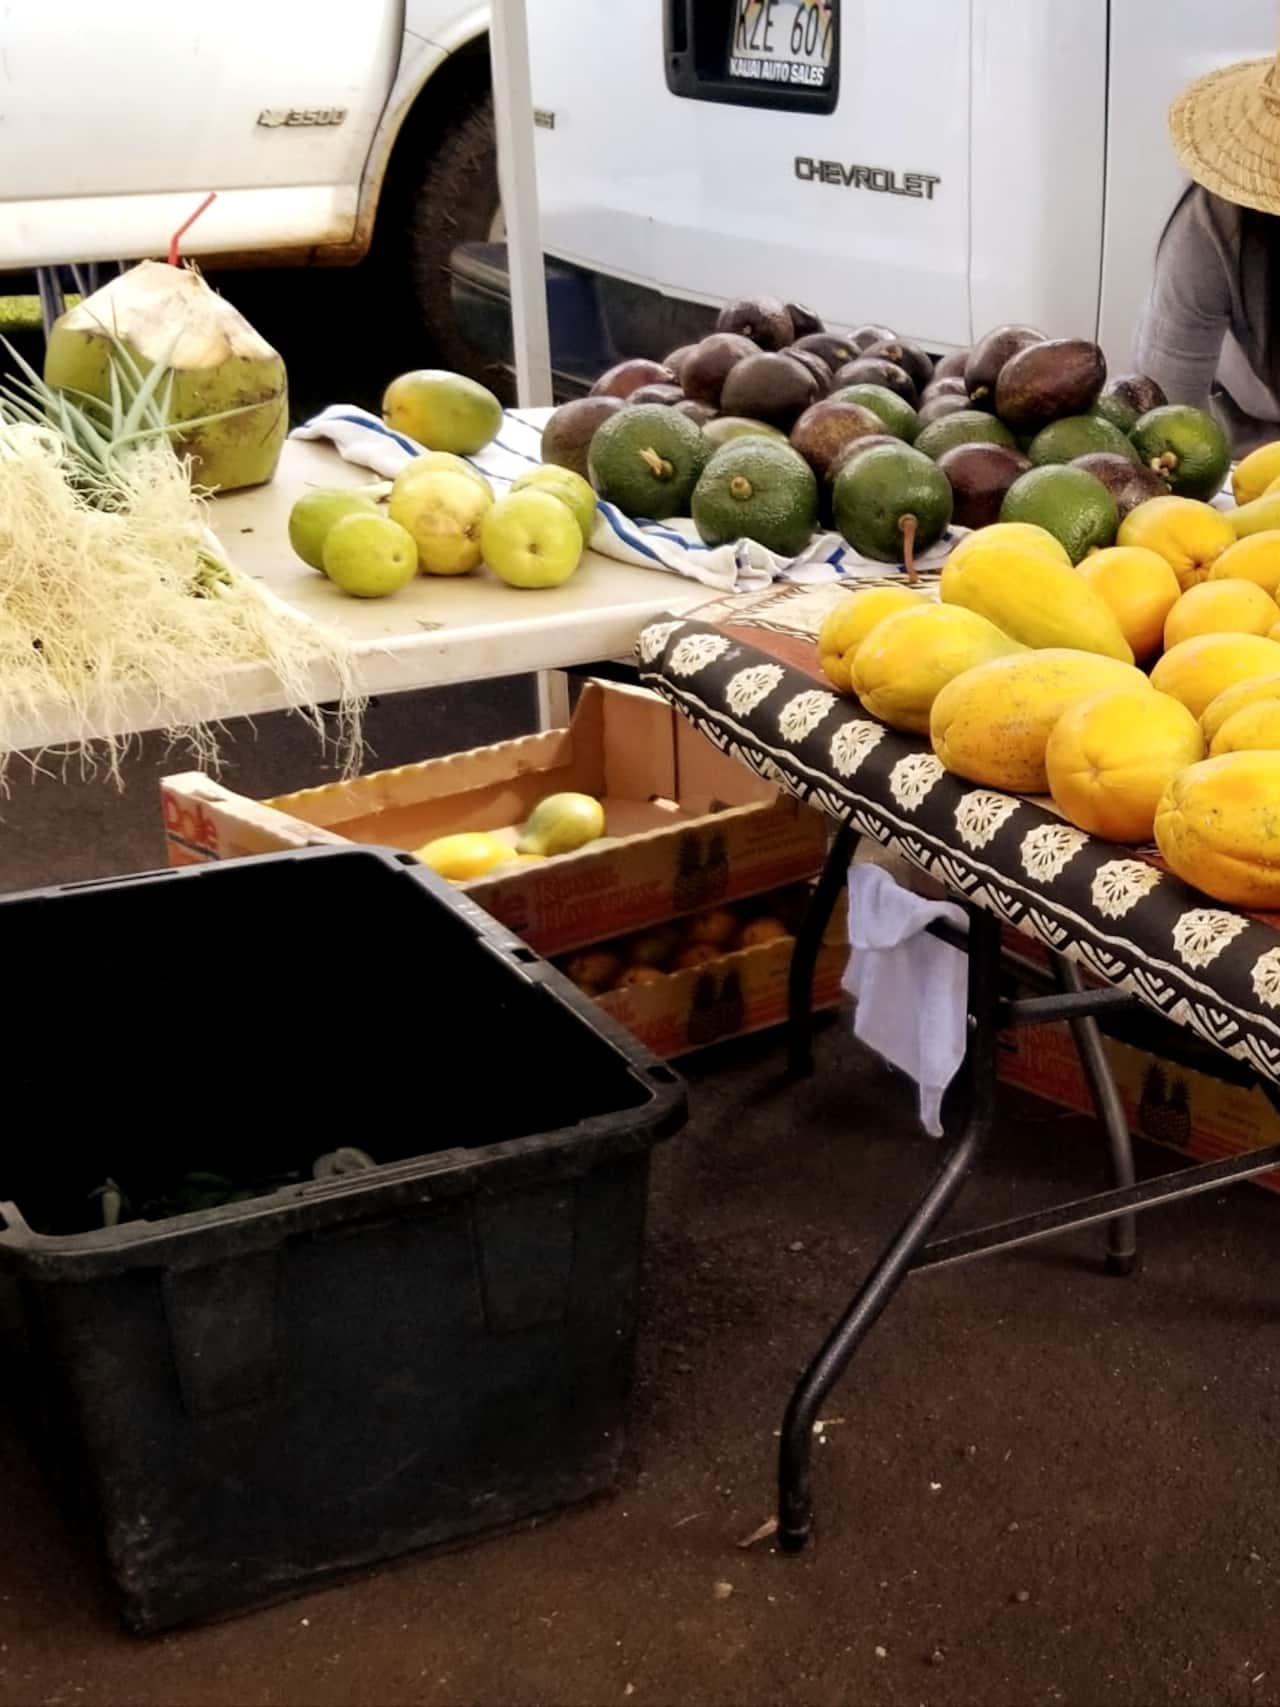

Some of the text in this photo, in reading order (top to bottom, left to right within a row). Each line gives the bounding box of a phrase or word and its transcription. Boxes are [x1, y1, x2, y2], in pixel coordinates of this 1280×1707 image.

[761, 61, 790, 82] AUTO
[790, 65, 825, 86] SALES
[794, 156, 941, 199] CHEVROLET
[163, 790, 218, 850] Dole
